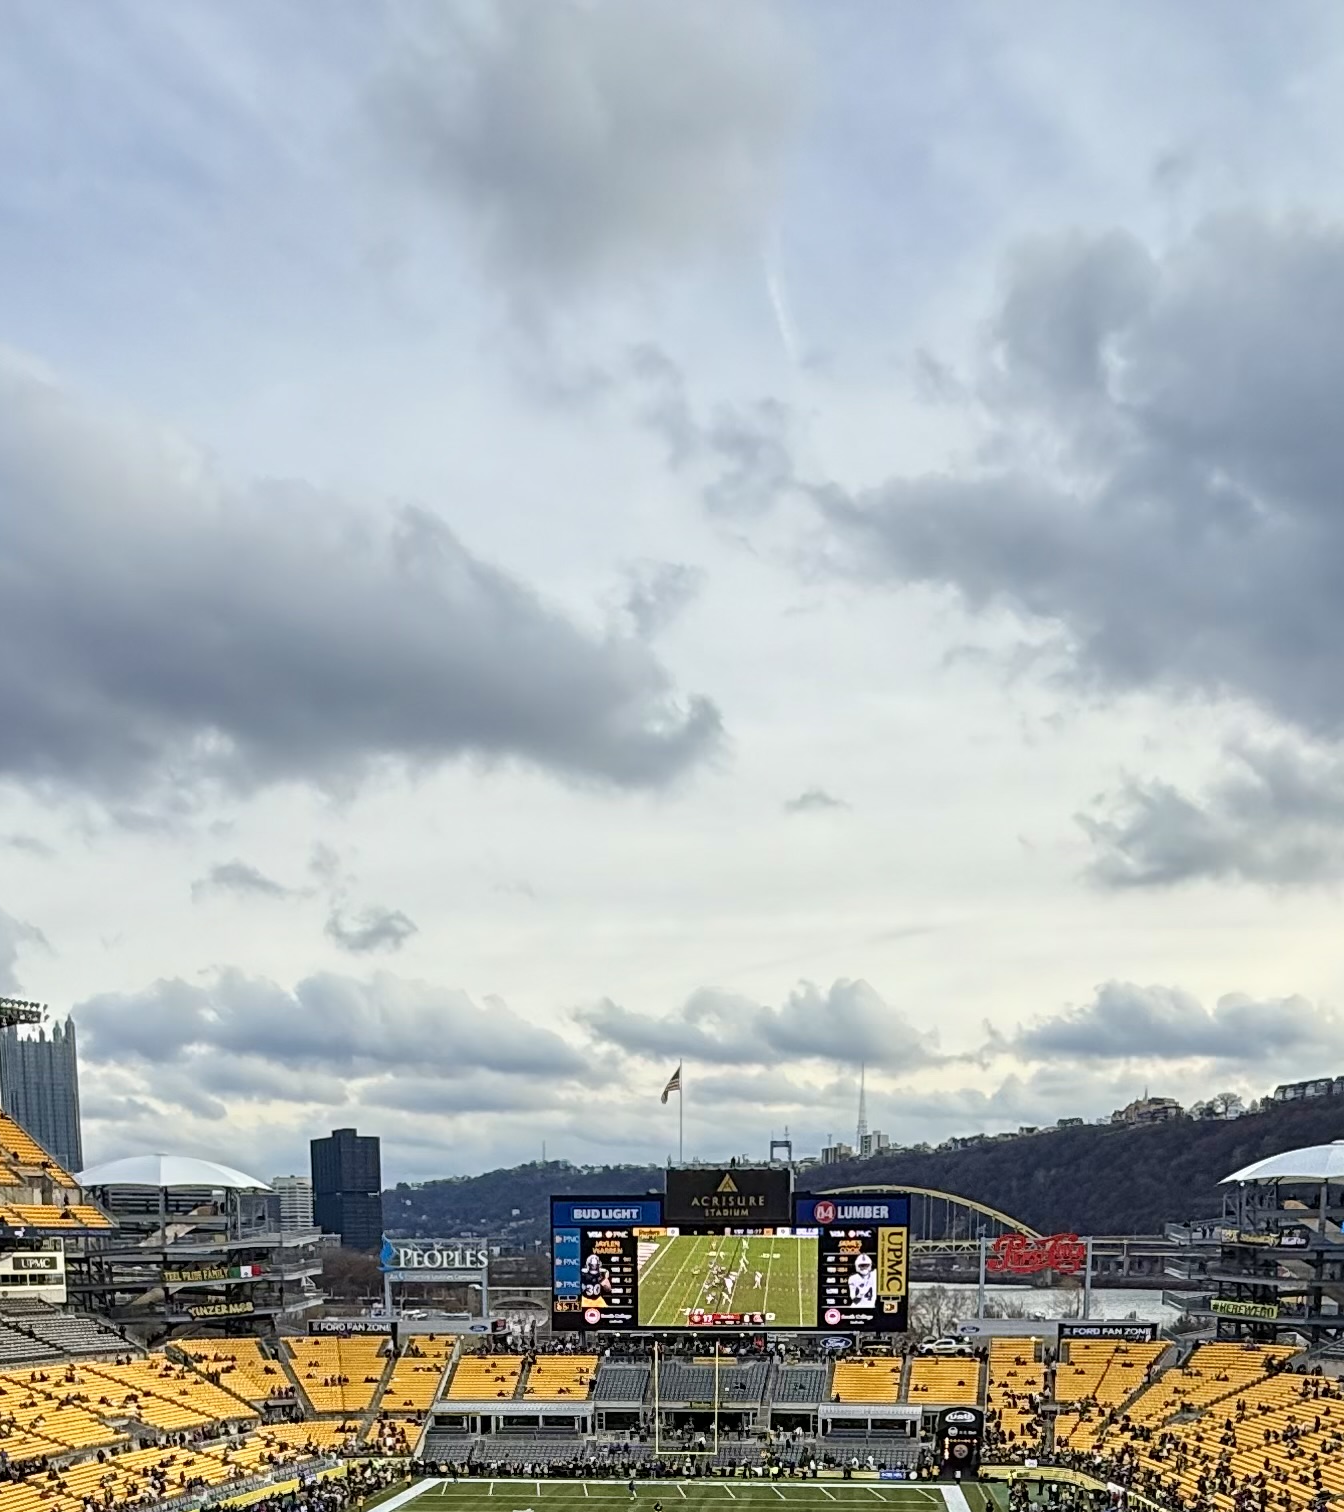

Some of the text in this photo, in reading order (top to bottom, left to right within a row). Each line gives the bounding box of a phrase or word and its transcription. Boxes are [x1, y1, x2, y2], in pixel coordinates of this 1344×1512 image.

[691, 1195, 765, 1207] ACRISURE
[573, 1209, 639, 1219] BUD LIGHT
[704, 1208, 749, 1217] STADIUM
[837, 1205, 889, 1219] LUMBER
[21, 1258, 51, 1268] UPMC
[398, 1248, 489, 1268] PEOPLES
[886, 1231, 904, 1292] UPMC
[1072, 1328, 1101, 1336] FORD
[1102, 1327, 1122, 1335] FAN
